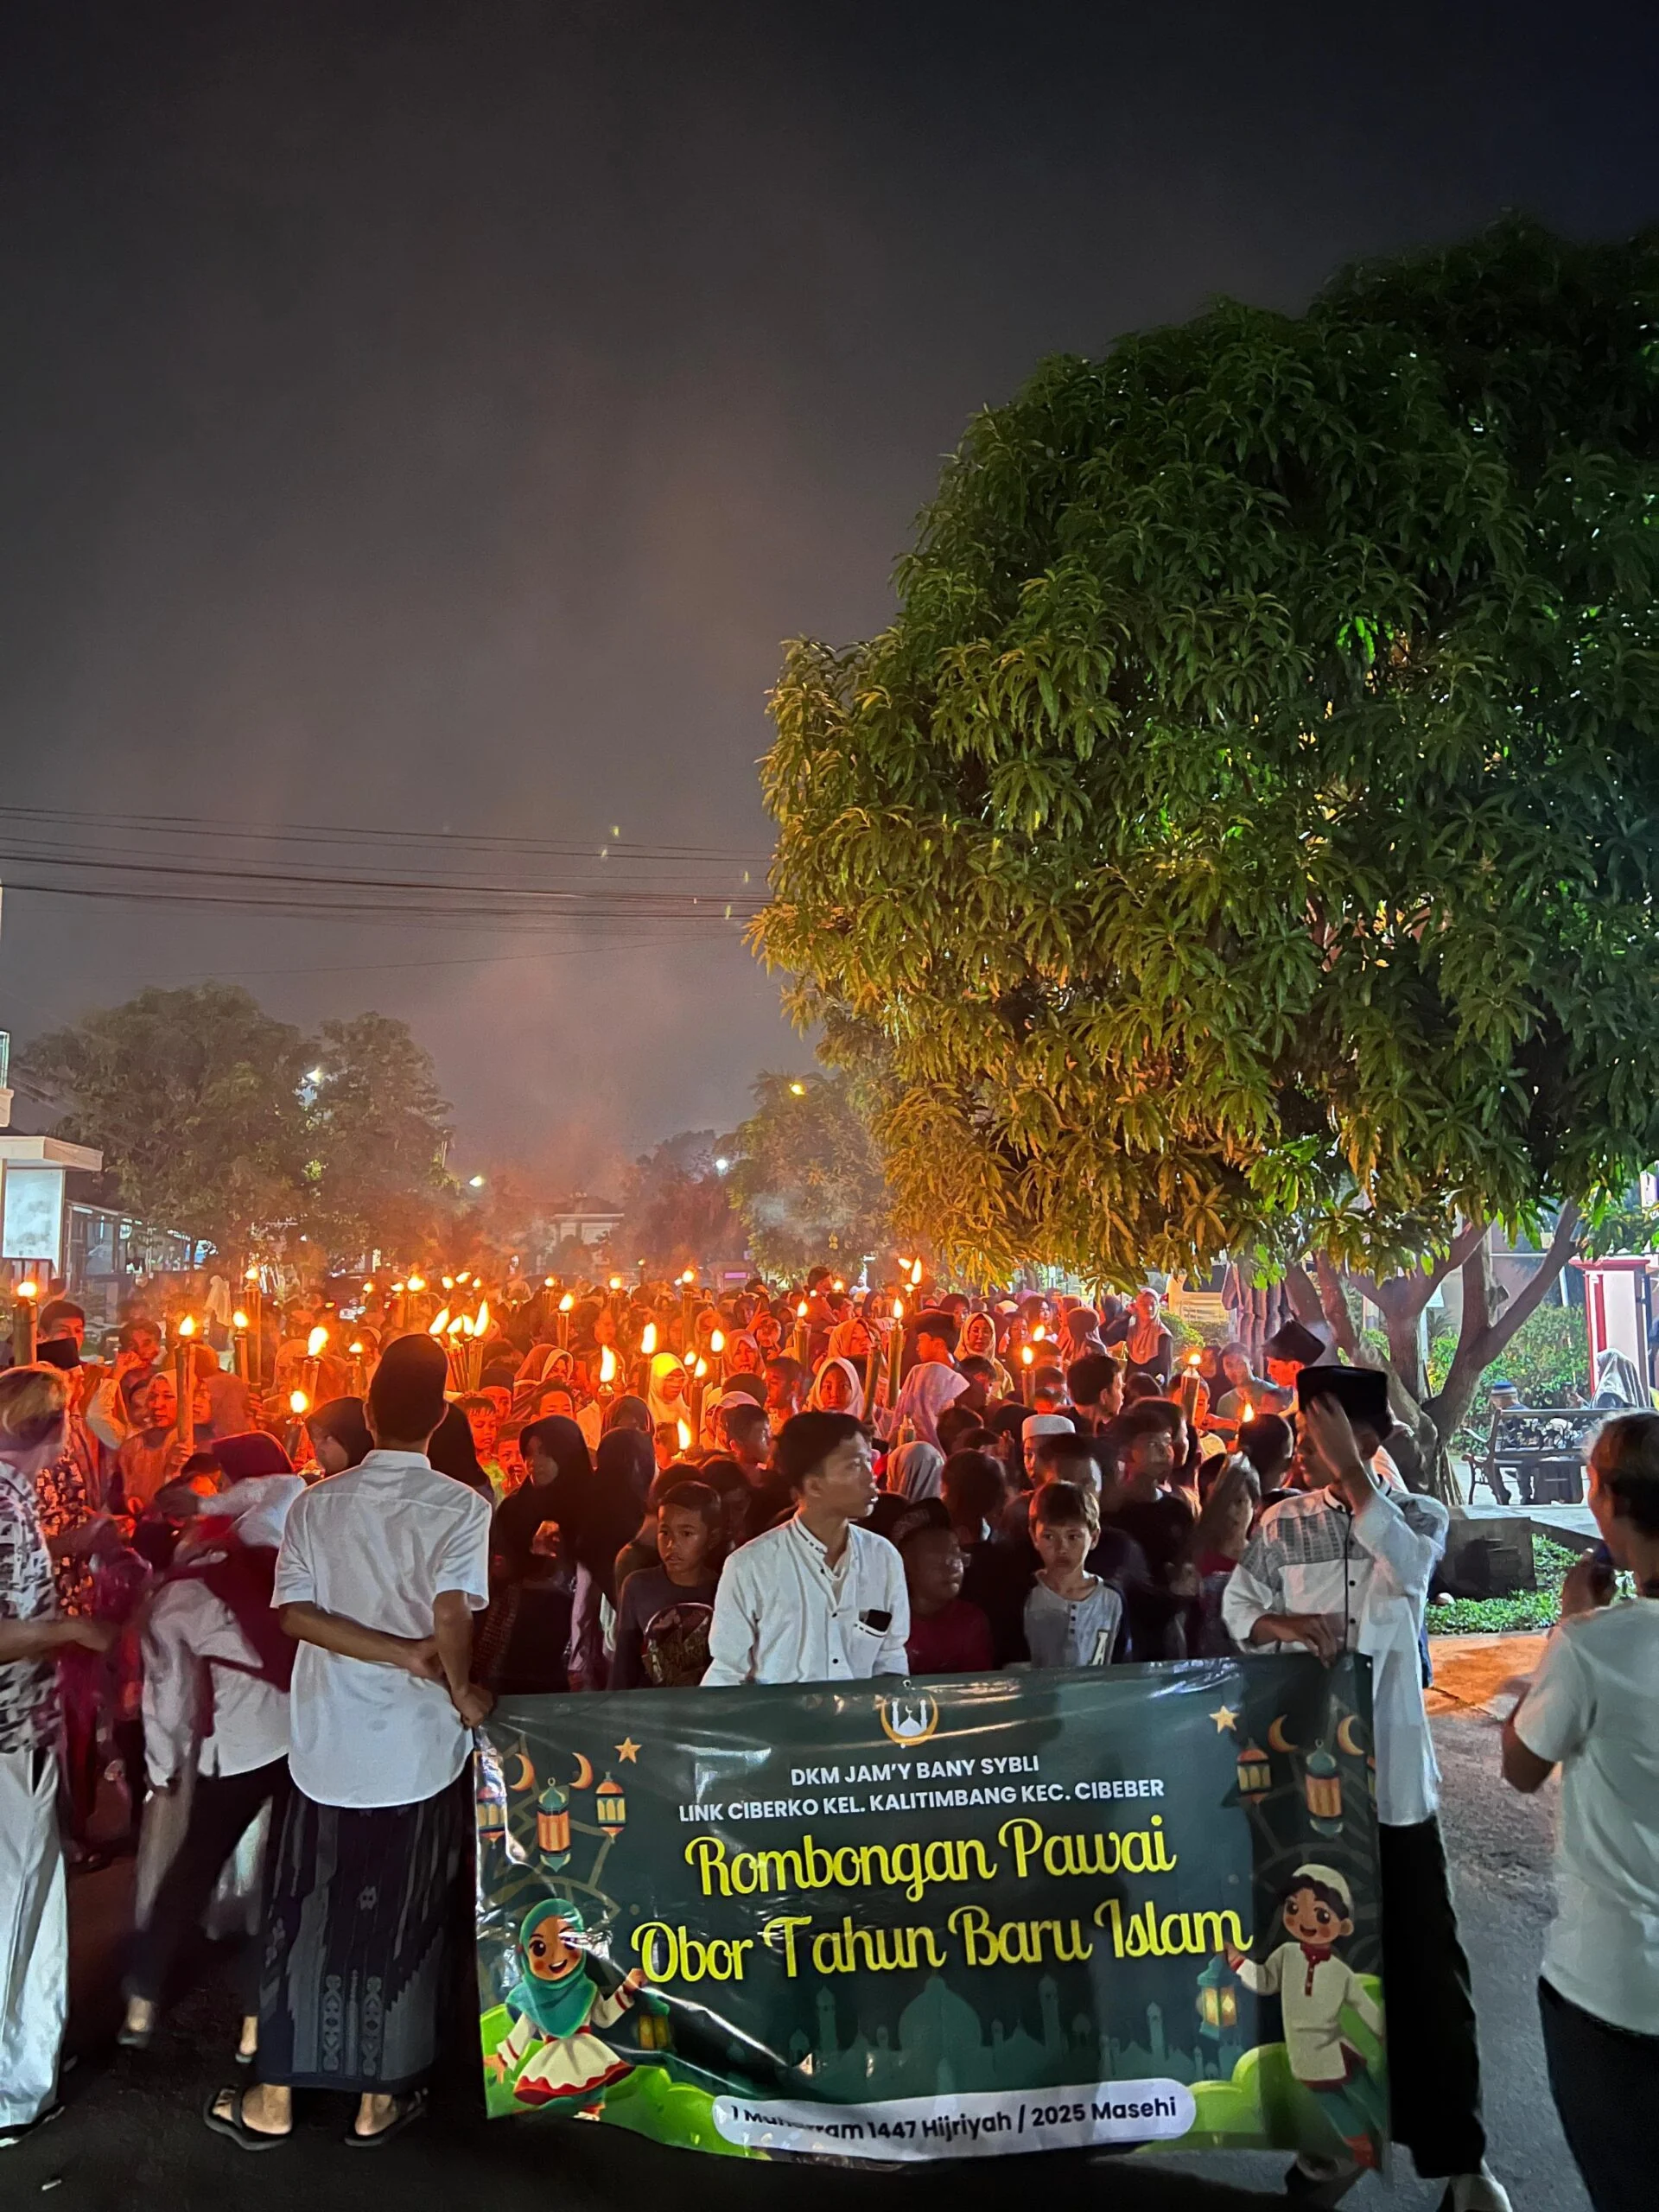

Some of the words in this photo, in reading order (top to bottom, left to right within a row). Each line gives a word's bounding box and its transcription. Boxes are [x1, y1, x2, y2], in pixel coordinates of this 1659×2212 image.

[791, 1766, 840, 1786] DKM
[917, 1759, 975, 1779] BANY
[981, 1755, 1039, 1774] SYBLI
[679, 1802, 723, 1821] LINK
[728, 1797, 819, 1820] CIBERKO
[823, 1796, 865, 1815] KEL.
[869, 1786, 1017, 1812] KALITIMBANG
[1021, 1783, 1071, 1803] KEC.
[1075, 1779, 1165, 1800] CIBEBER
[684, 1834, 997, 1902] Rombongan
[998, 1815, 1177, 1878] Pawai
[631, 1921, 753, 1983] Obor
[763, 1916, 947, 1978] Tahun
[948, 1905, 1092, 1967] Baru
[1094, 1898, 1254, 1958] Islam
[730, 2105, 739, 2120] 1
[866, 2120, 916, 2139] 1447
[922, 2111, 1012, 2142] Hijriyah
[1018, 2104, 1026, 2133] /
[1032, 2103, 1086, 2126] 2025
[1091, 2096, 1176, 2120] Masehi
